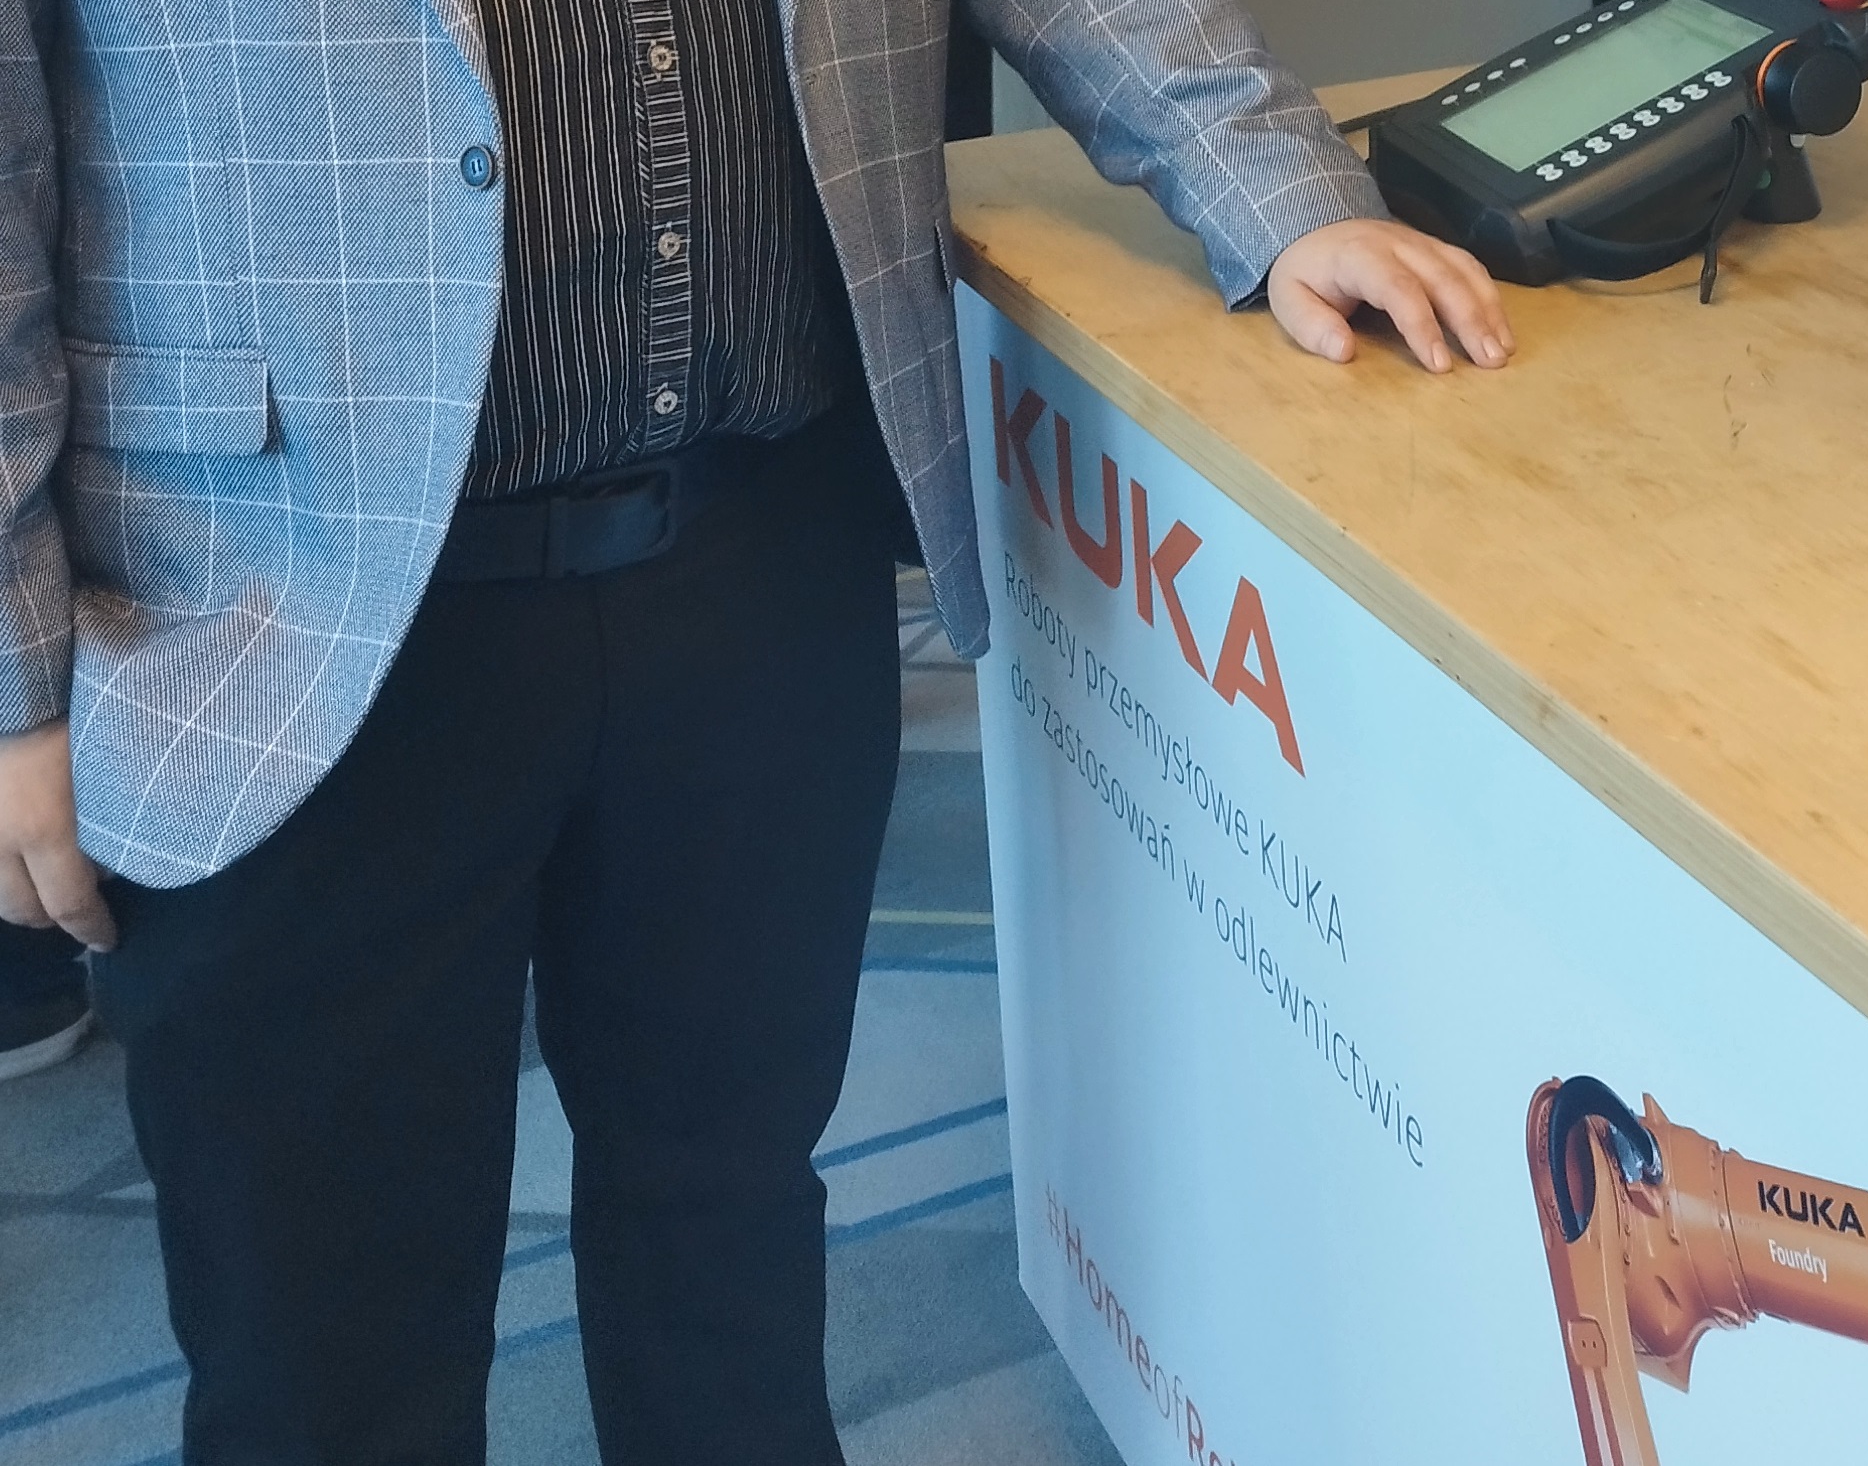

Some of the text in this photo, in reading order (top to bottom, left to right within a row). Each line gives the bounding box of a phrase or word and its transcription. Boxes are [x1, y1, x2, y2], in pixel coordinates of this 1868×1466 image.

[990, 354, 1306, 779] KUKA
[1004, 550, 1348, 964] Roboty przemysłowe KUKA
[1011, 655, 1424, 1168] do zastosowań w odlewnictwie
[1045, 1183, 1236, 1466] #HomeofR
[1758, 1180, 1866, 1239] KUKA
[1768, 1238, 1827, 1284] Foundry
